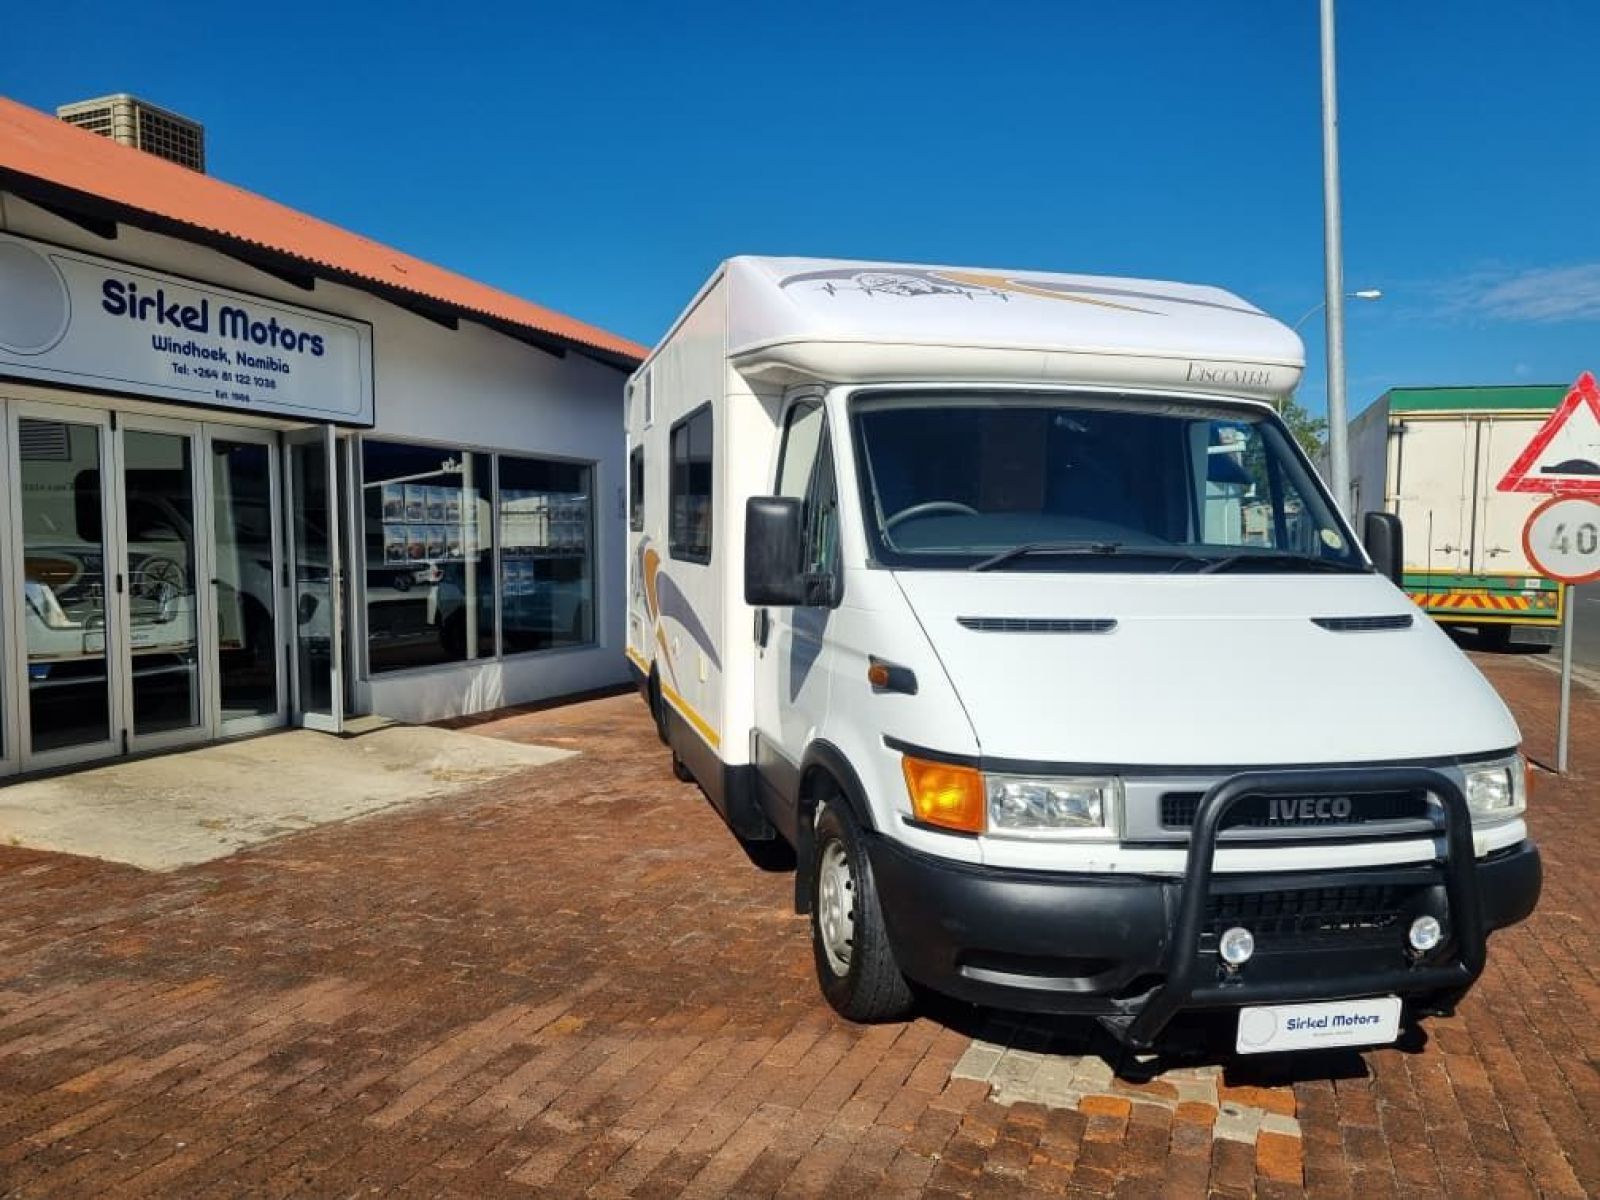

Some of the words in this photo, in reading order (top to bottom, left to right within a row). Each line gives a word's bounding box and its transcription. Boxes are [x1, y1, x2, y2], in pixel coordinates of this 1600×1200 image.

[102, 278, 209, 333] Sirkel
[219, 305, 325, 357] Motors
[152, 334, 231, 366] Windhoek,
[236, 350, 290, 375] Namibia
[172, 361, 190, 376] Tel:
[235, 373, 252, 386] 122
[1549, 523, 1598, 555] 40
[1268, 797, 1352, 820] IVECO
[1287, 1015, 1328, 1031] Sirkel
[1332, 1012, 1380, 1028] Motors
